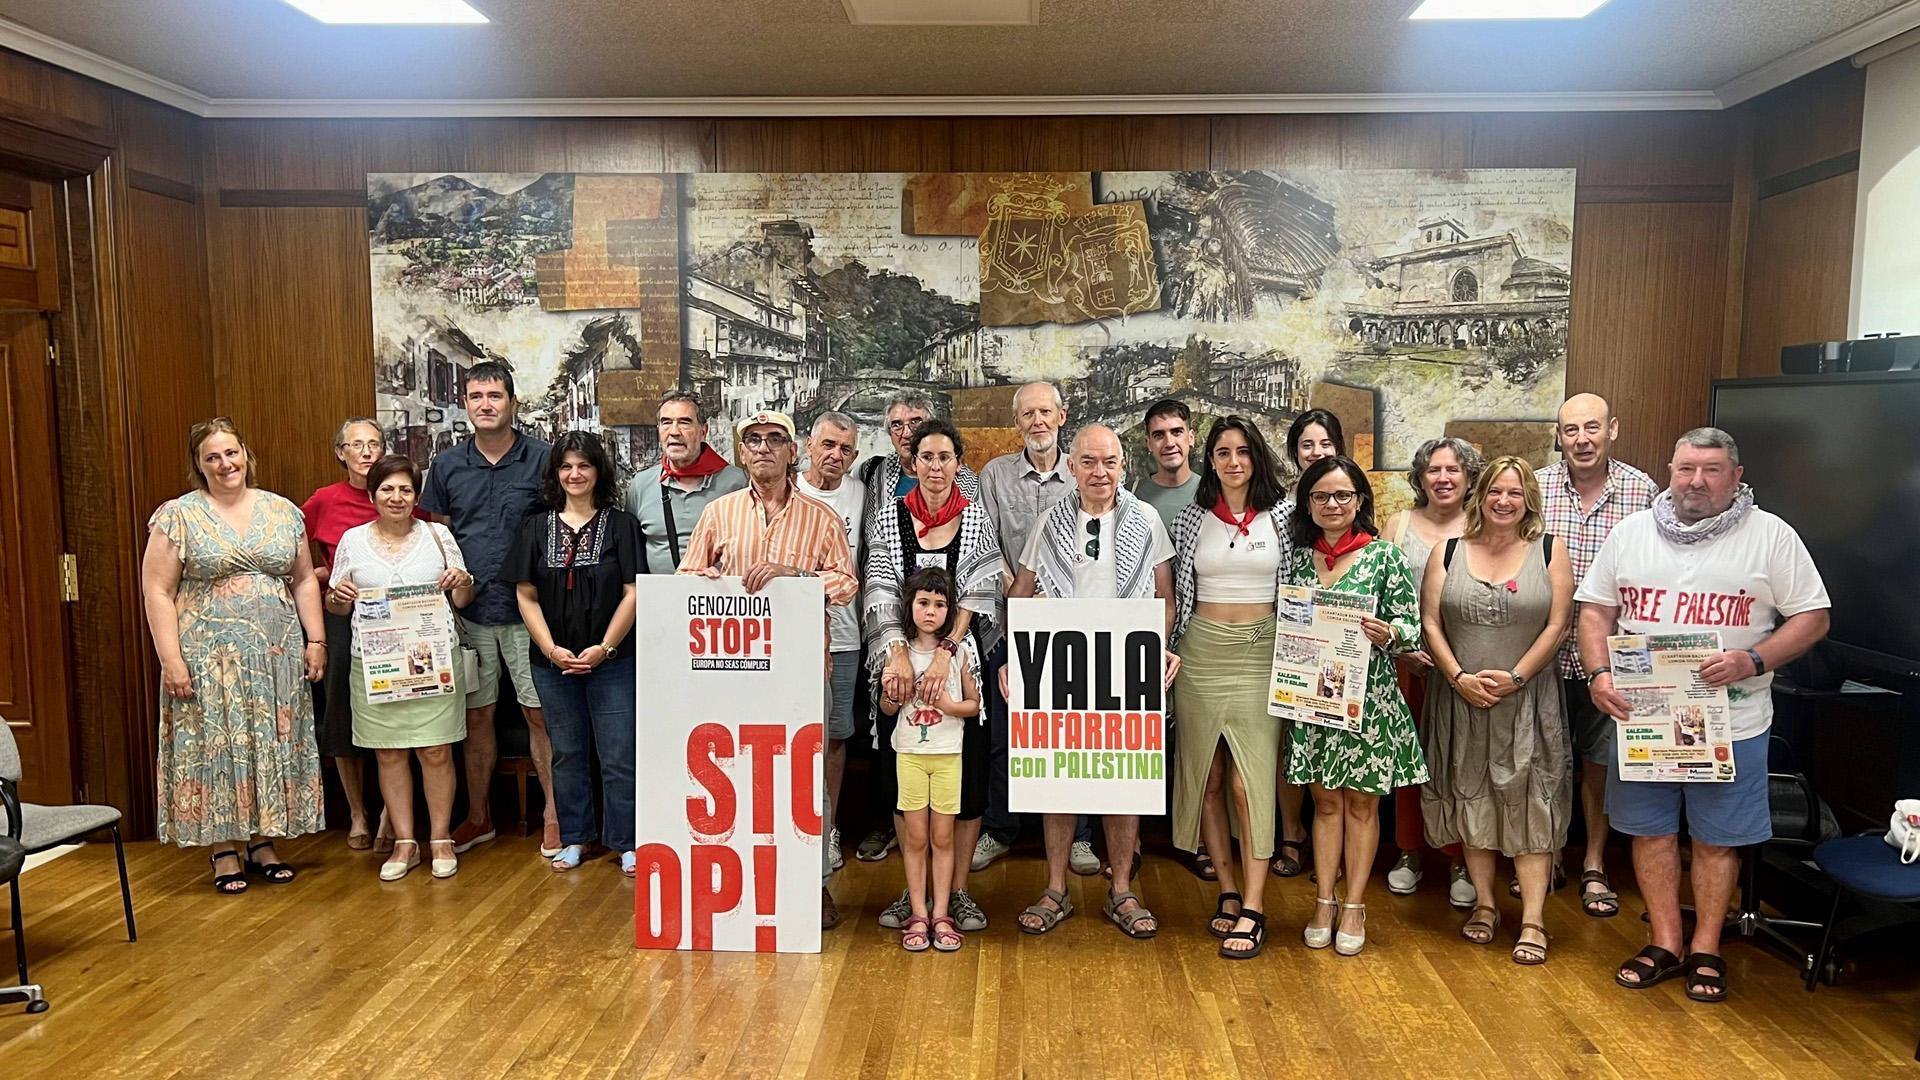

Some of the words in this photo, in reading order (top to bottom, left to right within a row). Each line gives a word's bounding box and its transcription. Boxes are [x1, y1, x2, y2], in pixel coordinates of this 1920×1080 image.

[688, 595, 771, 616] GENOZIDIOA
[1619, 586, 1668, 623] FREE
[689, 618, 772, 657] STOP!
[693, 660, 715, 669] EUROPA
[716, 660, 725, 669] NO
[725, 660, 740, 669] SEAS
[740, 659, 769, 670] CÓMPLICE
[1013, 630, 1162, 711] YALA
[1011, 711, 1162, 751] NAFARROA
[1010, 756, 1047, 779] con
[1053, 751, 1164, 781] PALESTINA
